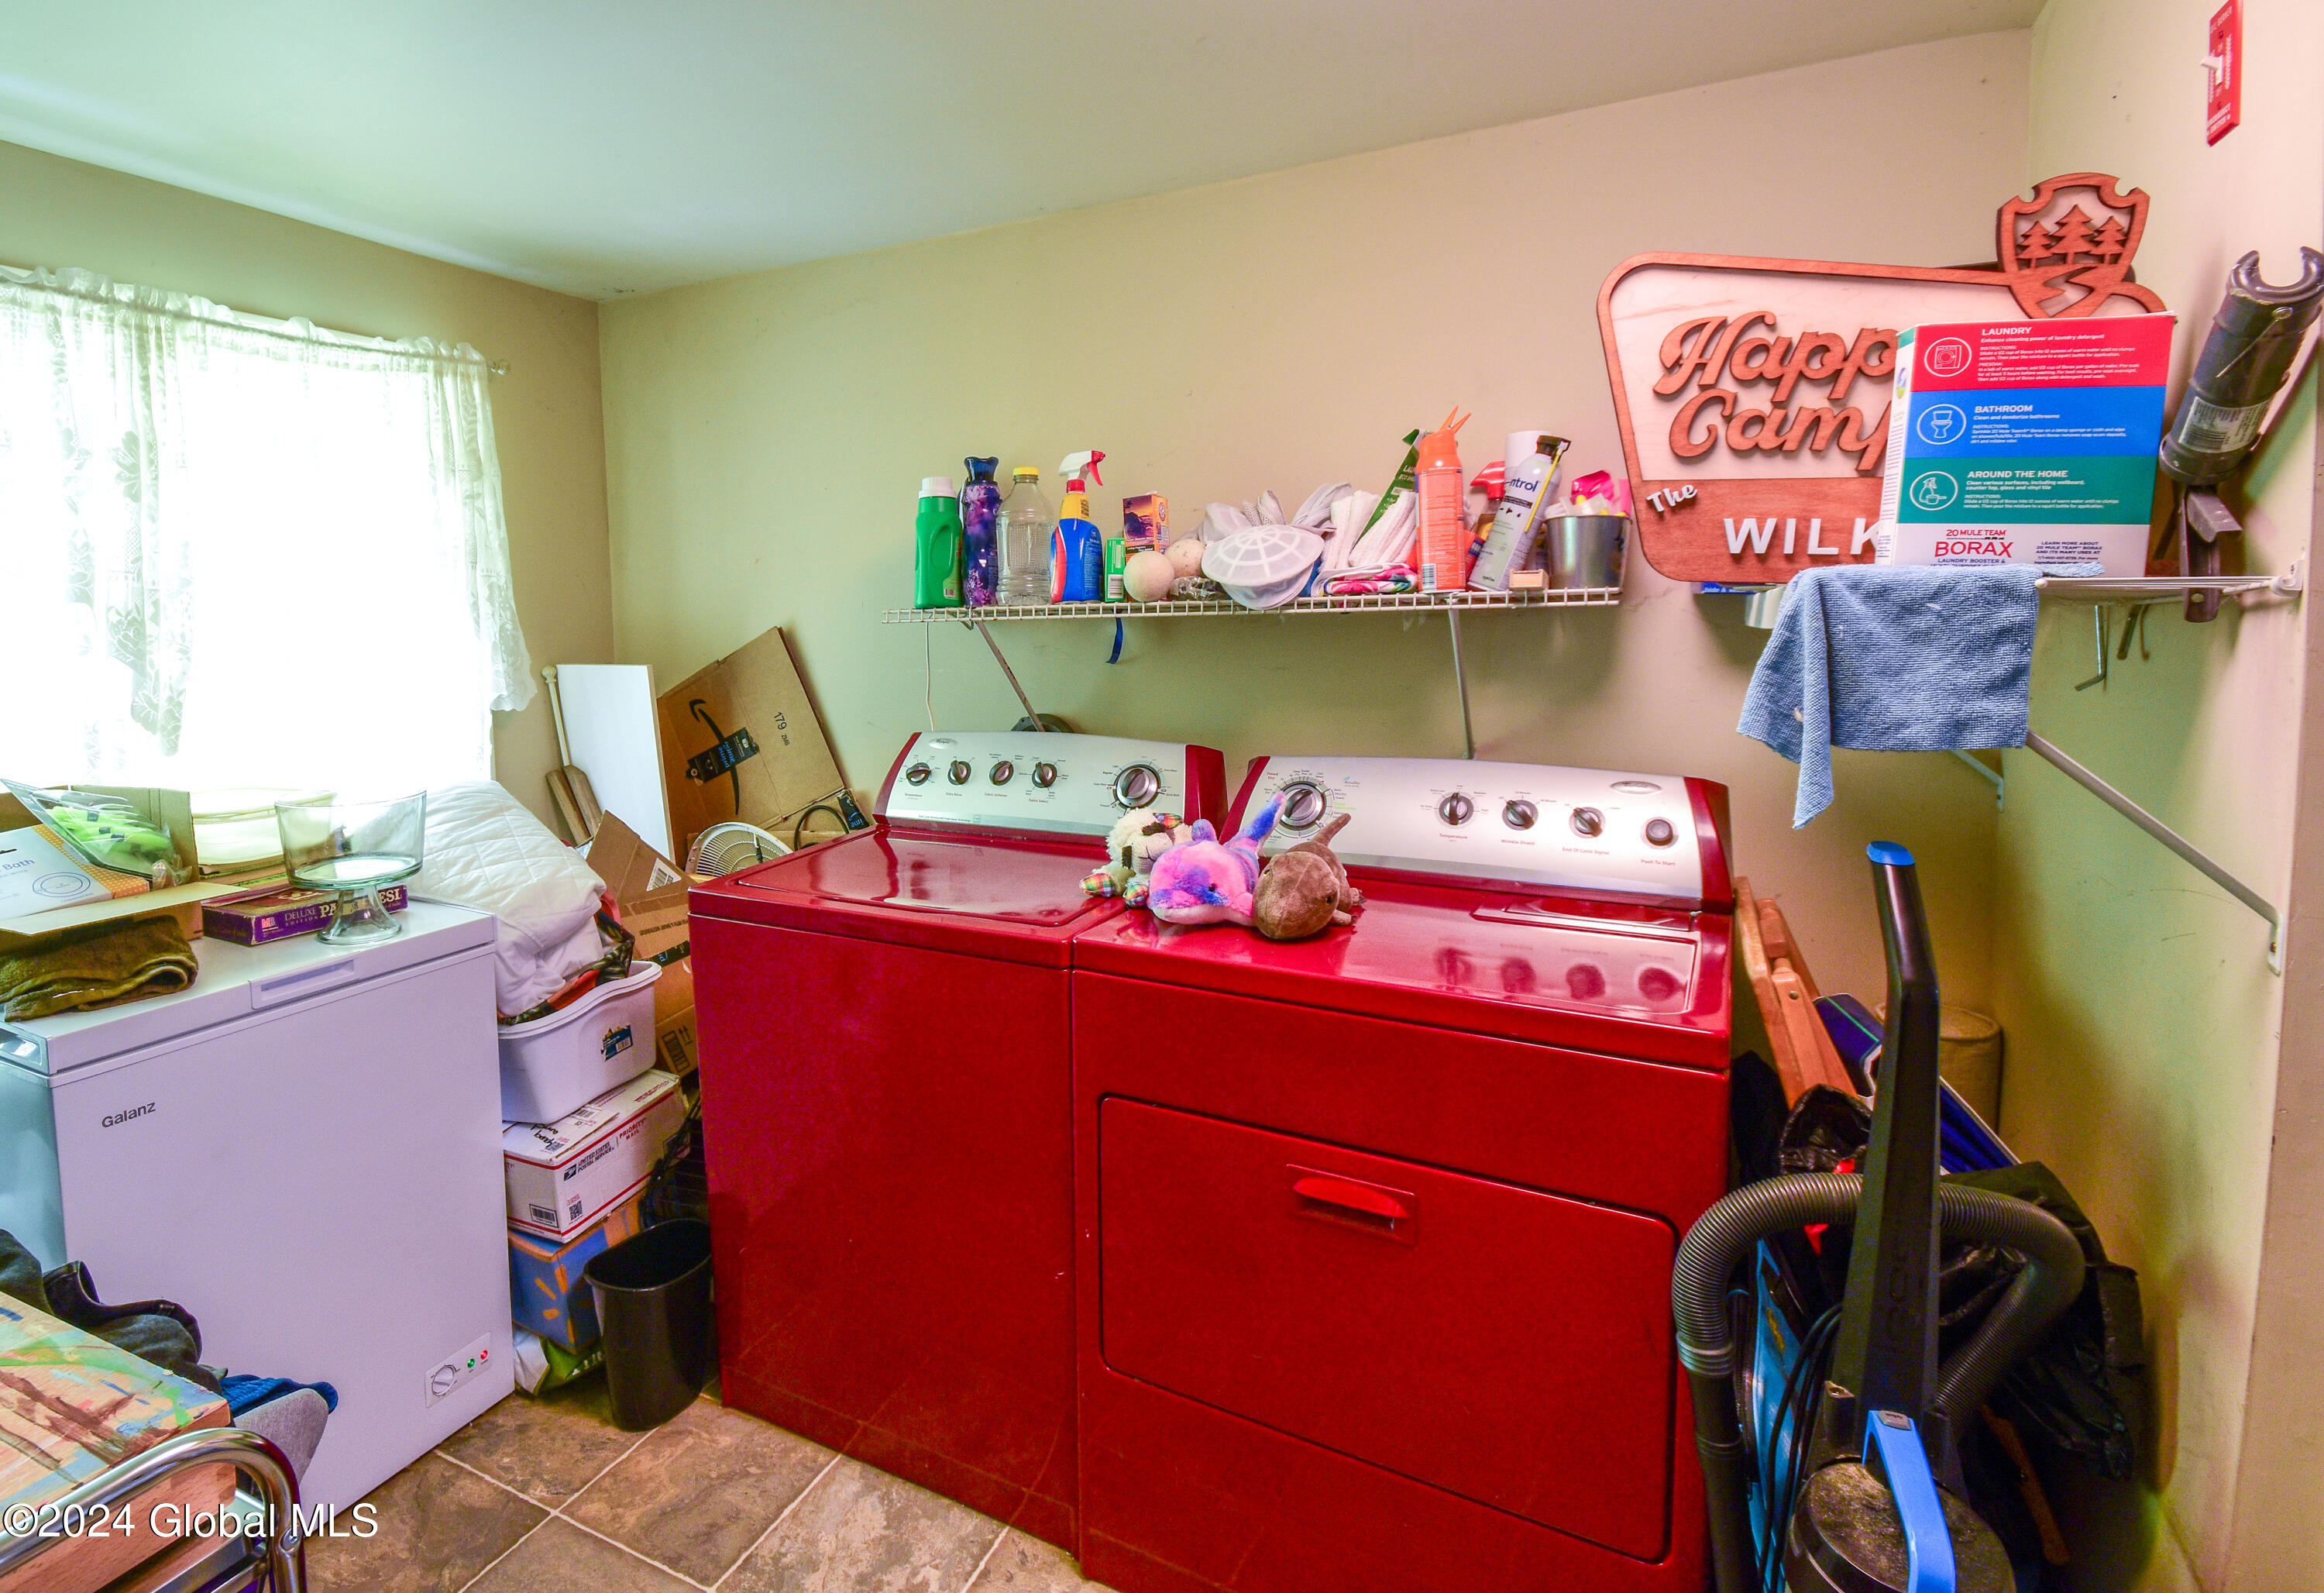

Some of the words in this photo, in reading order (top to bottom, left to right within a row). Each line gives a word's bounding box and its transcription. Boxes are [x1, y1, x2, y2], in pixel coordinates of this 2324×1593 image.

[1982, 327, 2033, 335] LAUNDRY
[1652, 311, 1898, 402] Happ
[2037, 470, 2069, 478] HOME
[1510, 477, 1539, 492] ntrol
[1646, 484, 1698, 512] The
[1934, 541, 2014, 558] BORAX
[774, 711, 787, 731] 179
[850, 817, 864, 827] ime
[2, 859, 35, 870] Bath
[284, 907, 317, 922] DELUXE
[285, 915, 318, 927] EDITION
[101, 1102, 156, 1128] Galanz
[619, 1117, 646, 1140] PRIORITY
[625, 1130, 639, 1141] MAIL
[578, 1151, 596, 1166] UNITED
[595, 1141, 610, 1157] STATES
[577, 1159, 595, 1173] POSTAL
